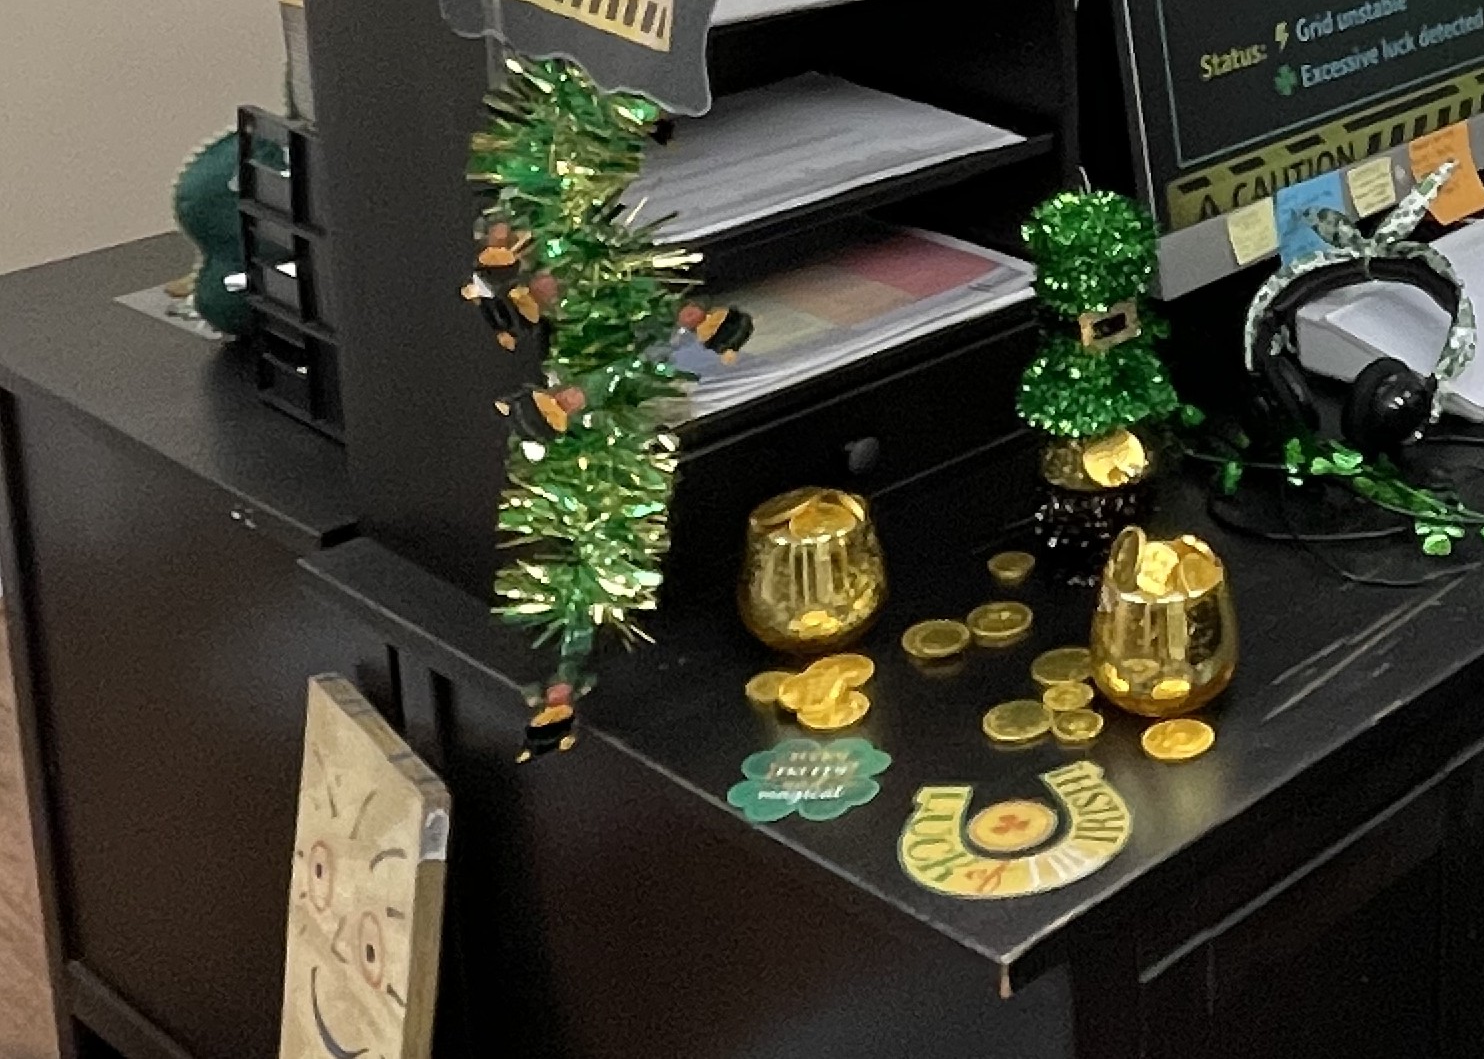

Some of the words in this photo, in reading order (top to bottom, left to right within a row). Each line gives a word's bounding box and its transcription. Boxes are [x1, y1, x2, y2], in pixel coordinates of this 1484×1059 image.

[1295, 14, 1334, 43] Grid
[1301, 48, 1379, 90] Excessive
[1382, 34, 1417, 64] luck
[1419, 8, 1484, 48] detected
[1200, 41, 1268, 82] Status:
[1232, 142, 1356, 204] CAUTION
